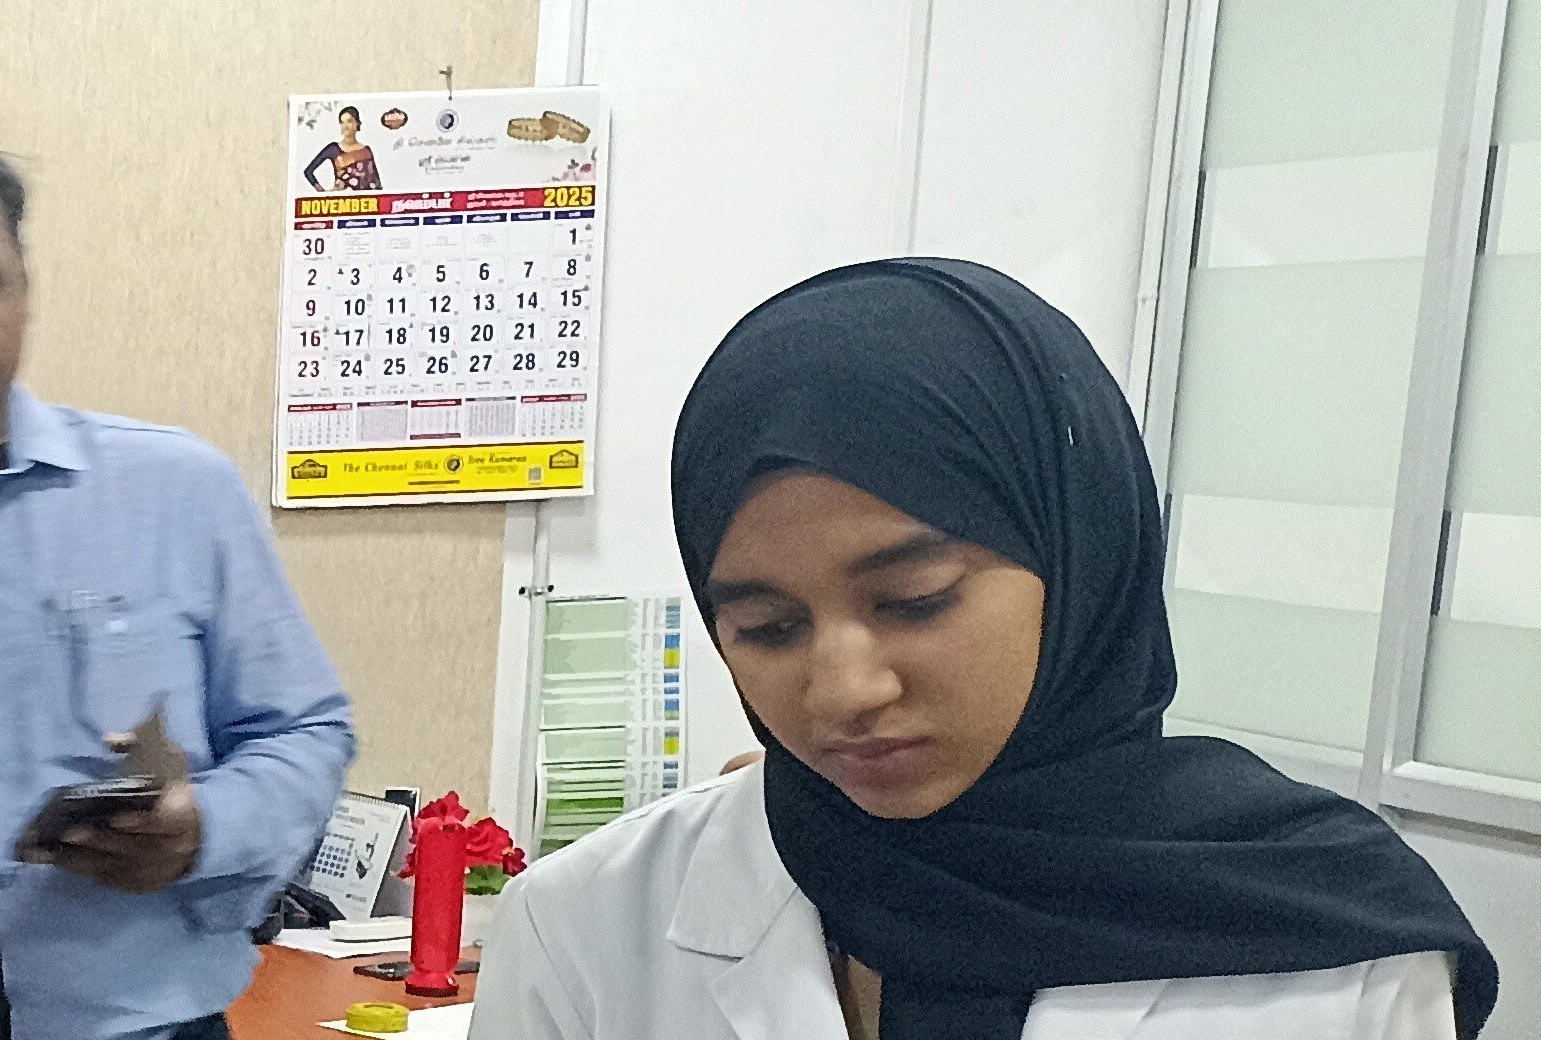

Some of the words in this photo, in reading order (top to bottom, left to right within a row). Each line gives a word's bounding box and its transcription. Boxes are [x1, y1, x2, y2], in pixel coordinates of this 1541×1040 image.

[300, 197, 379, 217] NOVEMBER
[543, 186, 595, 208] 2025
[302, 237, 325, 256] 30
[569, 228, 577, 245] 1
[307, 268, 317, 286] 2
[350, 267, 361, 286] 3
[392, 266, 404, 284] 4
[435, 264, 446, 283] 5
[479, 262, 490, 281] 6
[524, 261, 534, 278] 7
[566, 258, 577, 277] 8
[305, 299, 316, 317] 9
[344, 298, 366, 316] 10
[386, 297, 406, 314] 11
[429, 295, 451, 313] 12
[473, 293, 495, 311] 13
[516, 291, 538, 309] 14
[560, 289, 582, 307] 15
[300, 330, 321, 347] 16
[342, 329, 365, 347] 17
[385, 327, 407, 345] 18
[428, 325, 450, 344] 19
[470, 323, 494, 342] 20
[513, 322, 535, 341] 21
[557, 319, 581, 338] 22
[297, 360, 320, 378] 23
[340, 359, 363, 378] 24
[383, 357, 406, 376] 25
[425, 356, 449, 375] 26
[469, 354, 493, 373] 27
[512, 352, 536, 371] 28
[556, 350, 580, 369] 29
